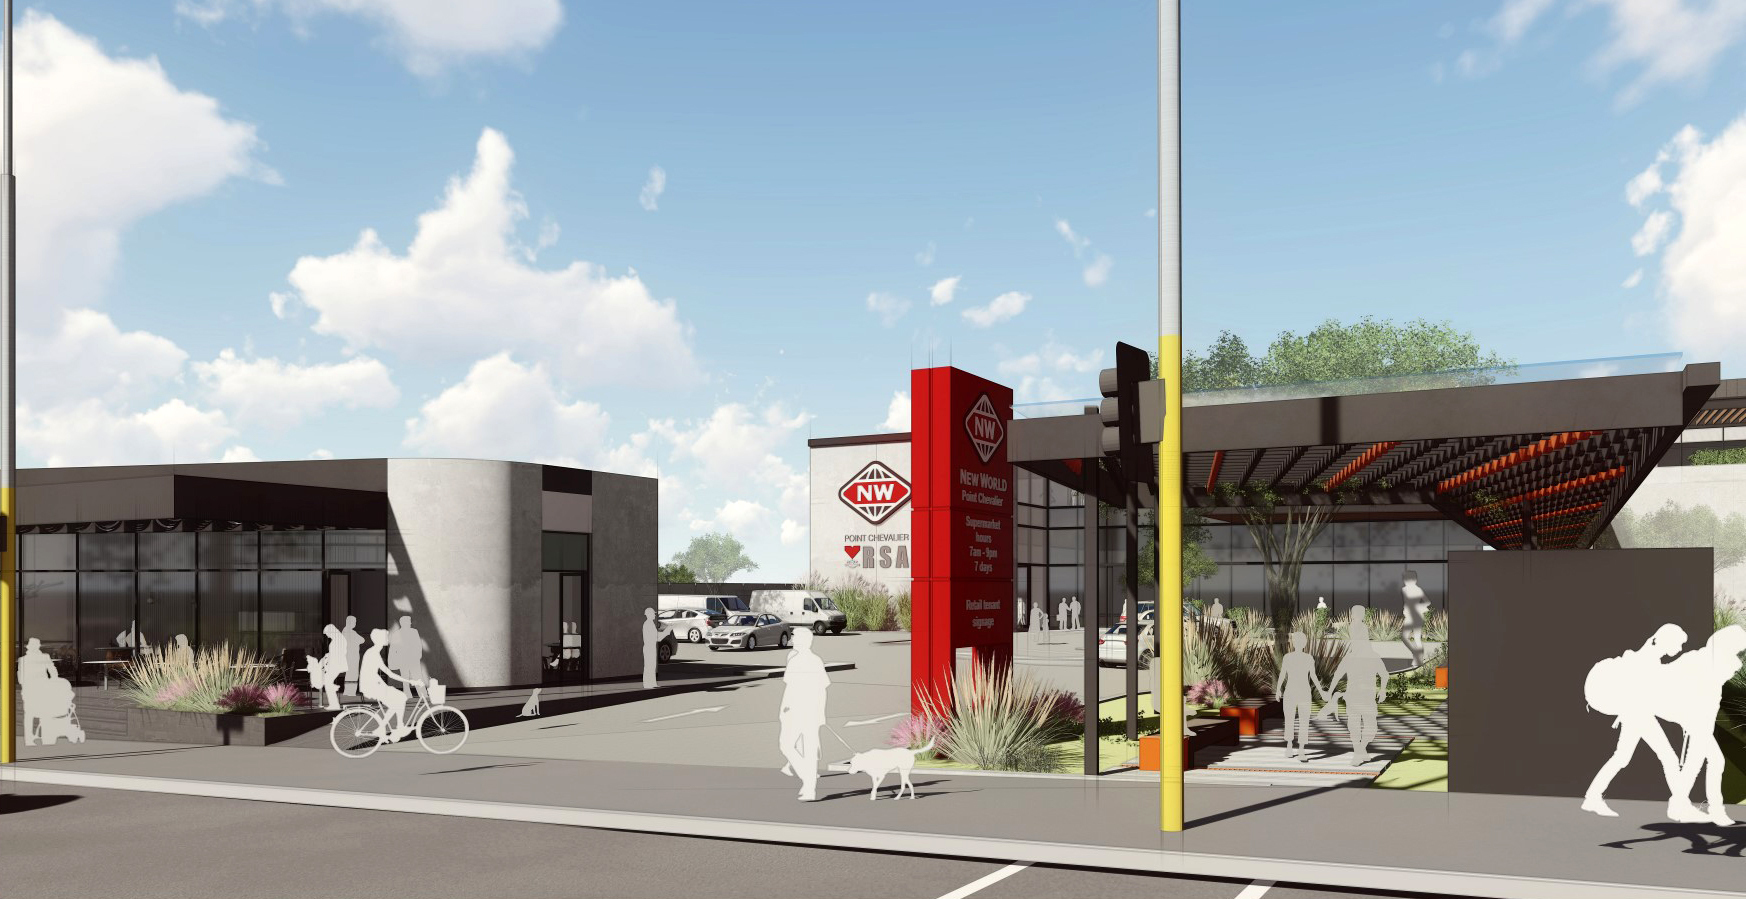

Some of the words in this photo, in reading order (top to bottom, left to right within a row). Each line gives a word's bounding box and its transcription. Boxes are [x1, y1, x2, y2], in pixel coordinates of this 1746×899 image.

[974, 416, 996, 441] NW
[959, 468, 979, 487] NEW
[980, 471, 1008, 493] WORLD
[857, 483, 895, 502] NW
[961, 489, 978, 503] Point
[978, 491, 1004, 507] Chevalier
[965, 515, 1001, 530] Supermarket
[844, 534, 866, 543] POINT
[868, 533, 909, 542] CHEVALIER
[975, 532, 992, 544] hours
[862, 545, 909, 569] RSA
[969, 546, 982, 557] 7am
[985, 548, 998, 560] 9pm
[974, 560, 979, 571] 7
[979, 561, 993, 575] days
[966, 599, 983, 611] Retail
[984, 599, 1001, 611] tenant
[972, 615, 995, 630] signage
